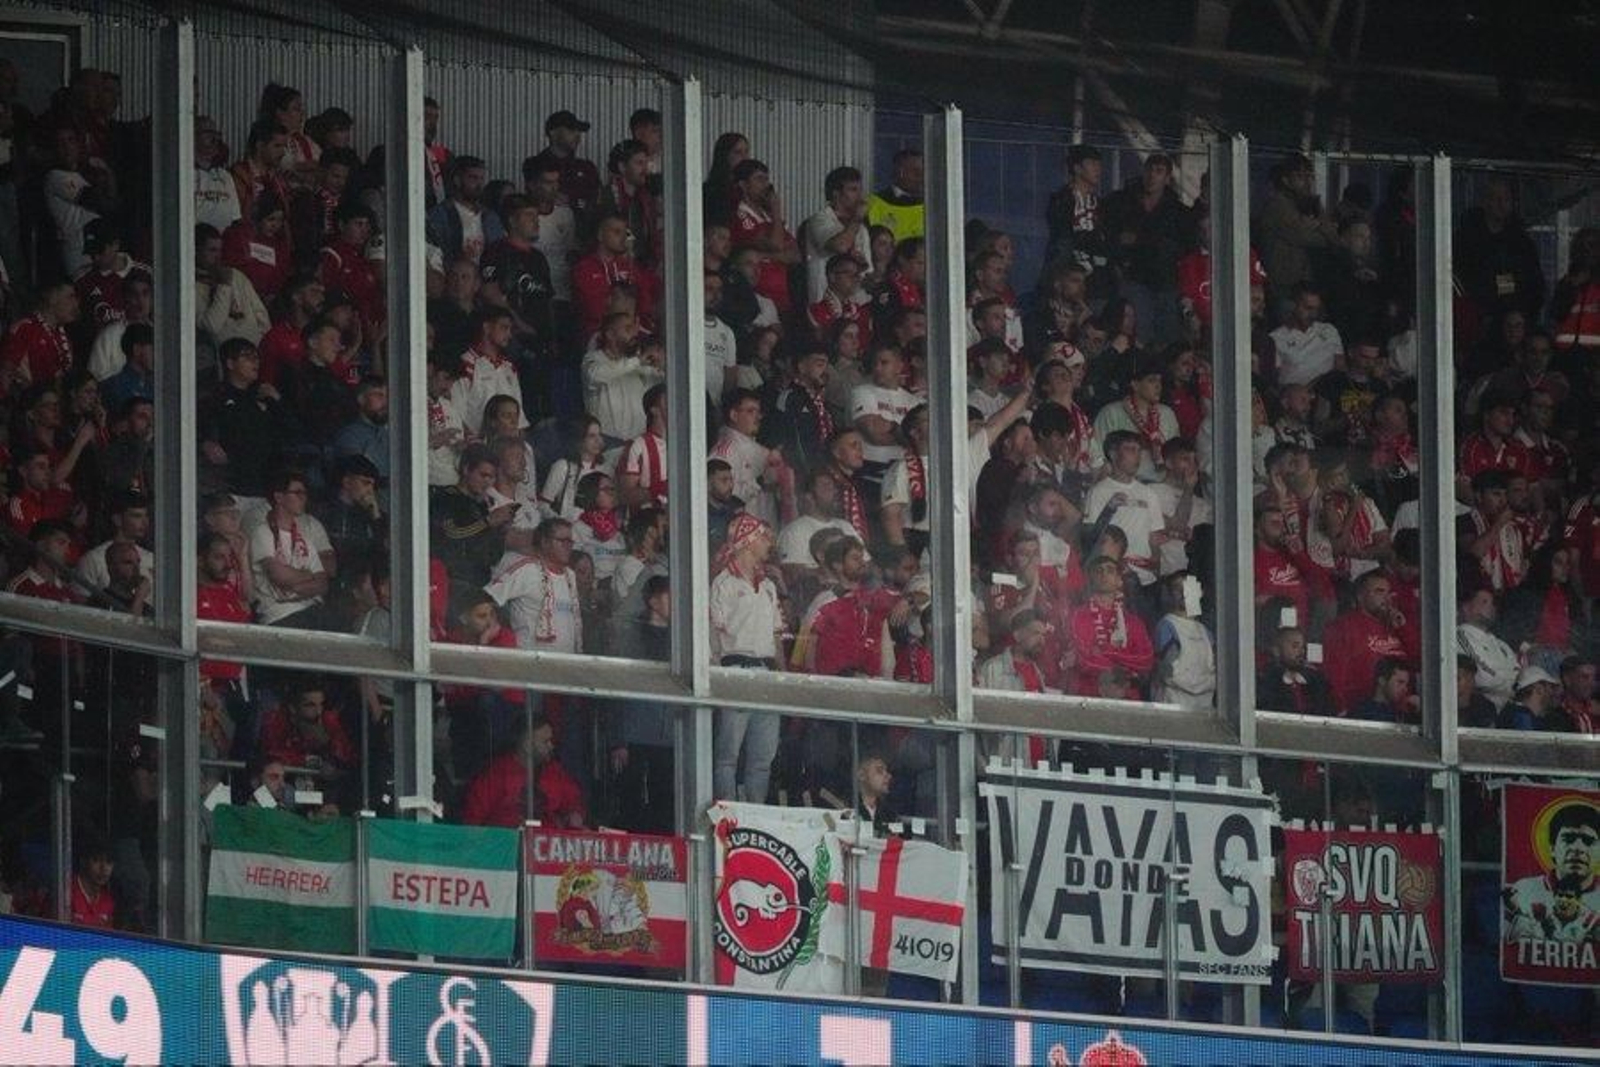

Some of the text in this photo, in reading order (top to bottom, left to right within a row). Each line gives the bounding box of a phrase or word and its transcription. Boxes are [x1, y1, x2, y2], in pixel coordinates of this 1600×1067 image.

[392, 872, 490, 908] ESTEPA
[1065, 856, 1190, 897] DONDE
[1323, 844, 1400, 909] SVQ
[894, 934, 955, 962] 41019
[1516, 938, 1597, 969] TERRA
[0, 945, 162, 1067] 49
